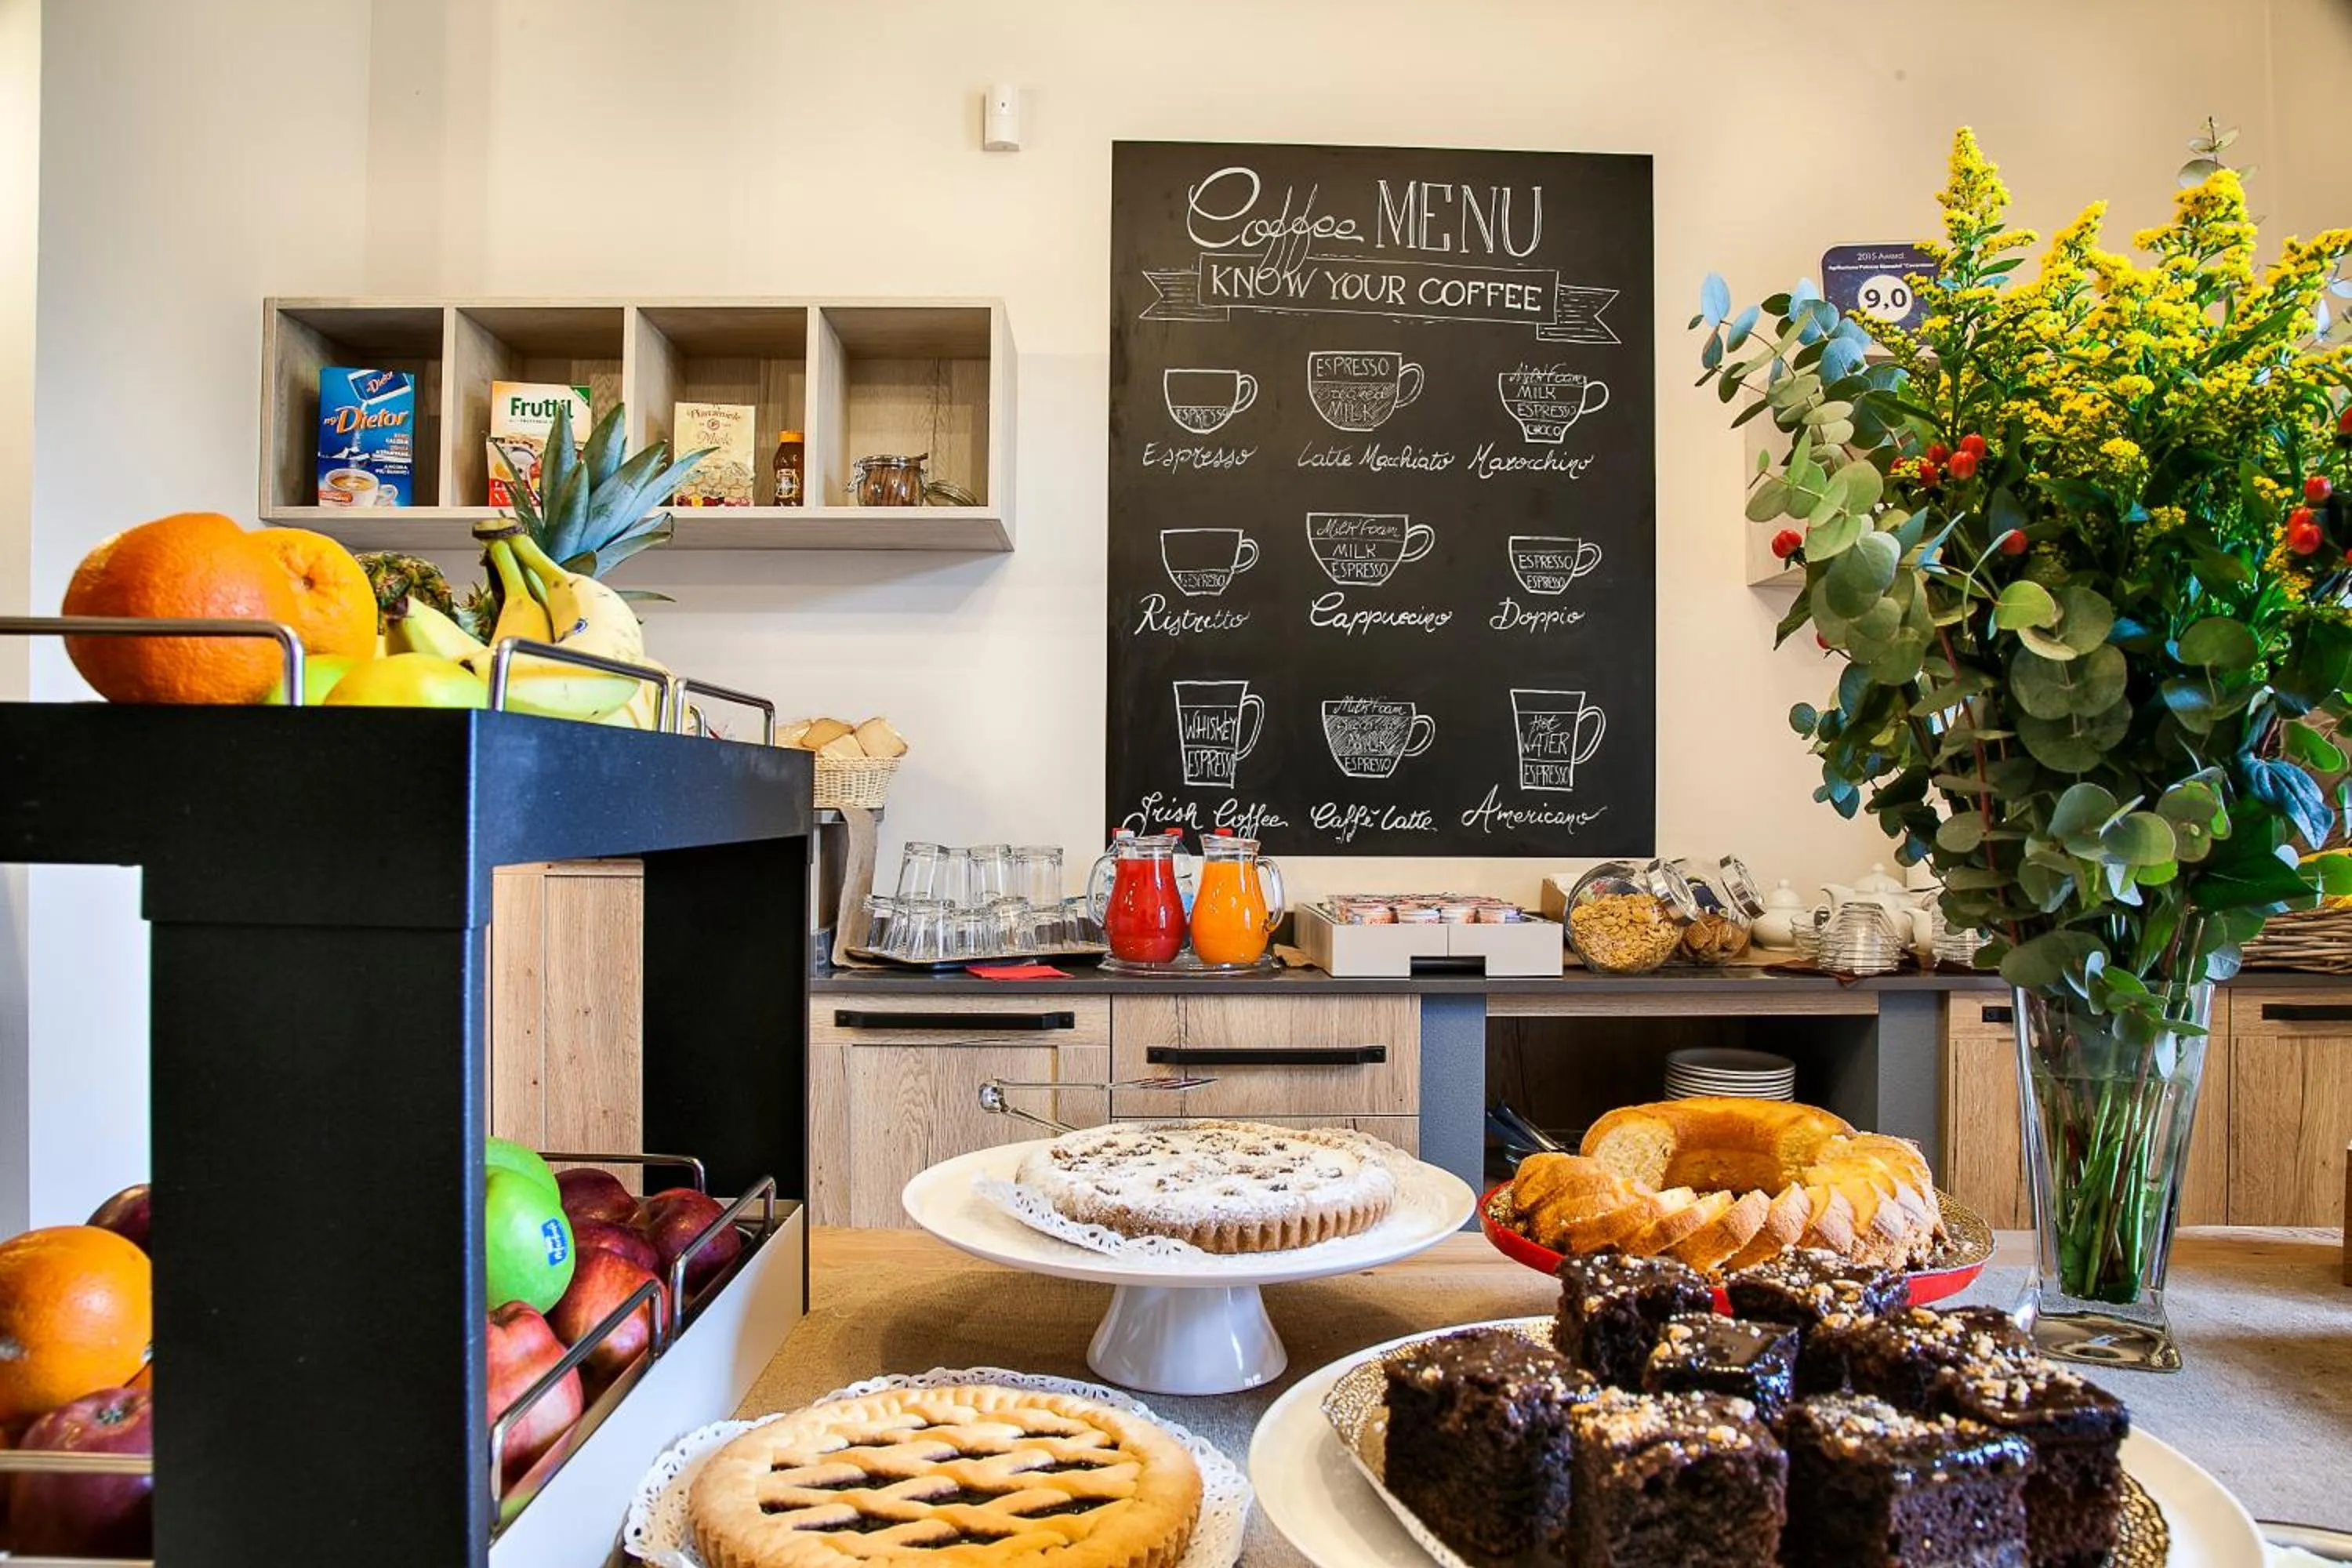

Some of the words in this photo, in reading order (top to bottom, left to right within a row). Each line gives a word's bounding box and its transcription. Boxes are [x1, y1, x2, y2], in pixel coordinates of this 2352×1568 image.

[1187, 167, 1364, 279] Coffee
[1376, 180, 1542, 257] MENU
[1857, 252, 1877, 261] 2015
[1211, 264, 1318, 298] KNOW
[1324, 270, 1405, 305] YOUR
[1418, 278, 1542, 310] COFFEE
[1864, 288, 1907, 310] 9,0
[1316, 356, 1389, 377] ESPRESSO
[1518, 385, 1556, 401] MILK
[1517, 403, 1577, 419] ESPRESSO
[1142, 441, 1258, 474] Espresso
[1298, 440, 1353, 466] Latte
[1332, 543, 1376, 558] MILK
[1517, 554, 1573, 570] ESPRESSO
[1331, 561, 1388, 579] ESPRESSO
[1134, 593, 1250, 636] Ristretto
[1490, 597, 1585, 633] Doppio
[1184, 710, 1238, 743] WHISKEY
[1521, 731, 1570, 757] WATER
[1345, 757, 1392, 772] ESPRESSO
[1121, 791, 1203, 838] Irish
[1213, 798, 1288, 839] Coffee
[1381, 806, 1438, 832] Latte
[1461, 784, 1607, 833] Americano
